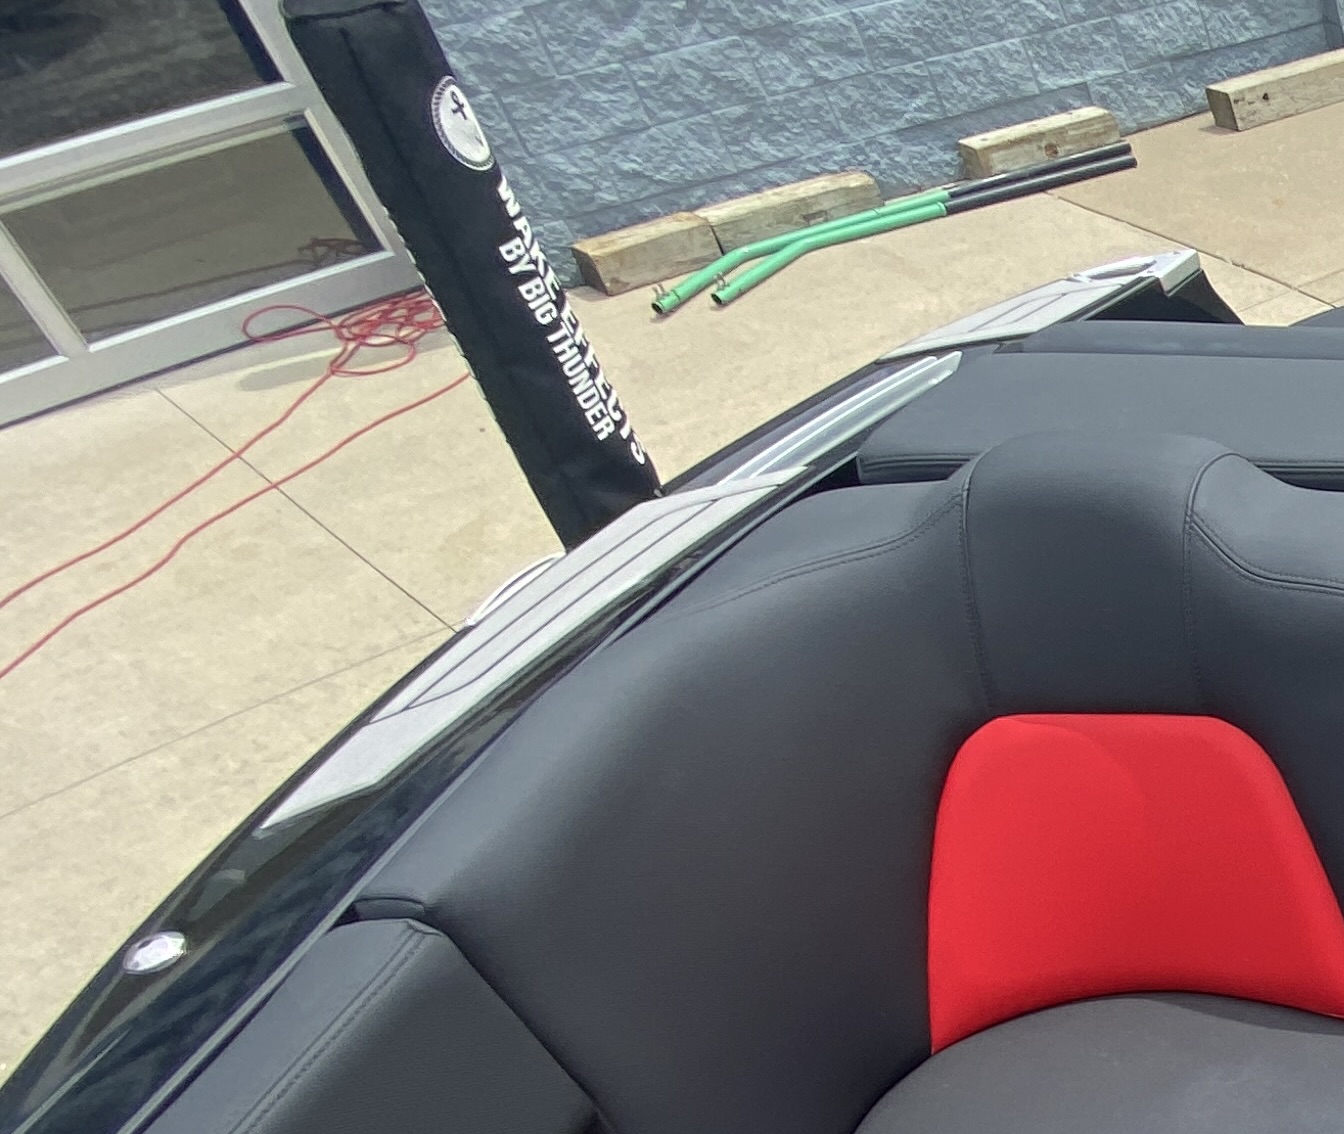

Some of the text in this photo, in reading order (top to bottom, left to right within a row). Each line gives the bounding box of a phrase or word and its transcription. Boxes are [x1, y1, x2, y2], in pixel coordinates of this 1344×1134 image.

[498, 175, 647, 465] WAKE EFFECTS
[499, 236, 615, 441] BY BIG THUNDER
